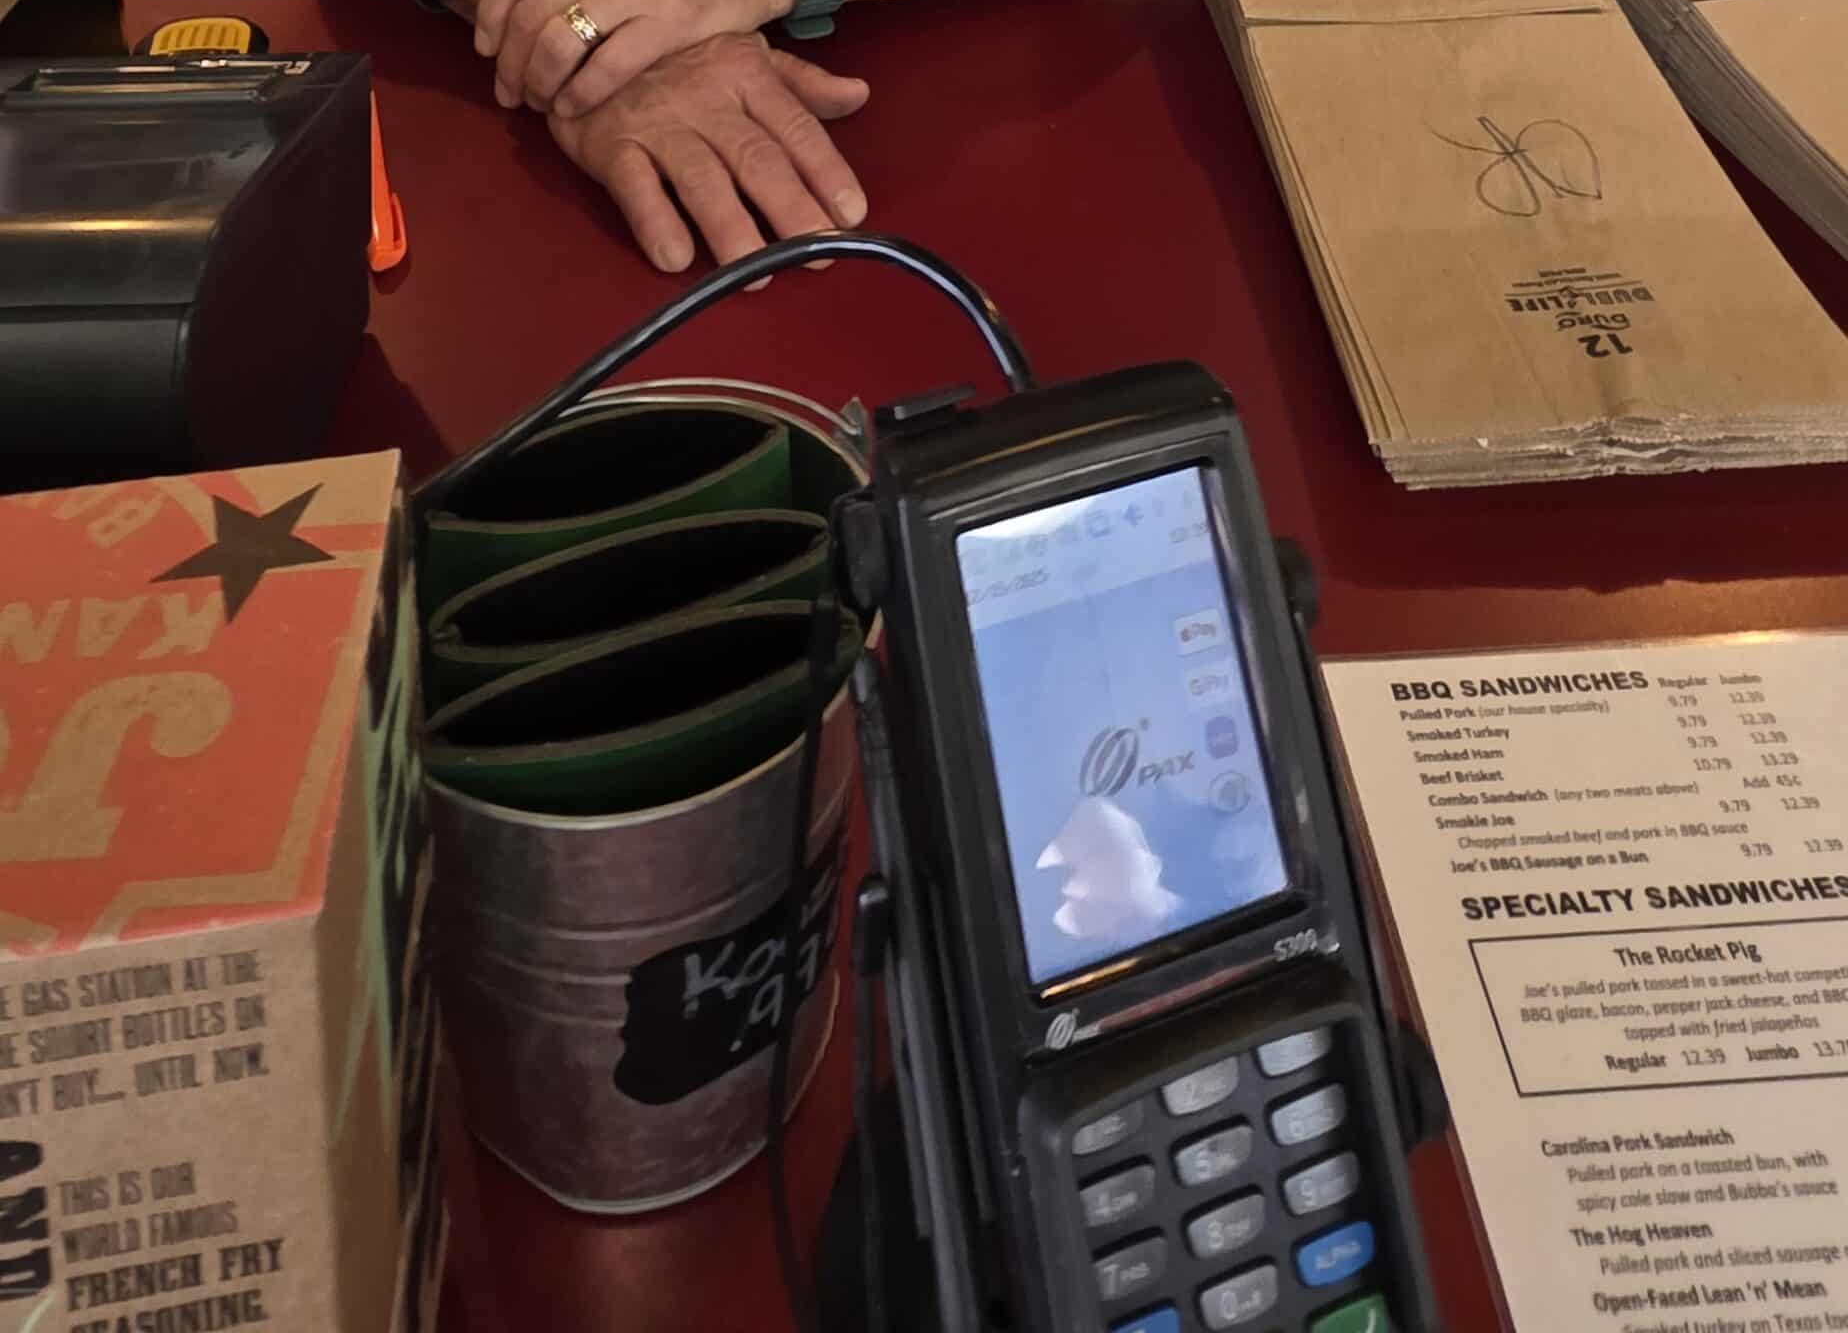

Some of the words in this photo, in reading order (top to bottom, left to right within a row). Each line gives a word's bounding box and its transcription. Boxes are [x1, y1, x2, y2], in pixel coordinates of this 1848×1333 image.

[1577, 333, 1633, 358] 12
[1391, 681, 1453, 701] BBQ
[1460, 671, 1648, 698] SANDWICHES
[1400, 708, 1442, 721] Pulled
[1445, 706, 1476, 719] Pork
[1407, 728, 1461, 742] Smoked
[1463, 725, 1510, 740] Turkey
[1138, 751, 1195, 787] PAX
[1414, 749, 1469, 763] Smoked
[1471, 748, 1504, 760] Ham
[1420, 771, 1451, 785] Beef
[1455, 770, 1504, 783] Brisket
[1428, 793, 1478, 807] Combo
[1480, 789, 1548, 804] Sandwich
[1554, 789, 1582, 803] (any
[1585, 787, 1609, 799] two
[1614, 784, 1653, 797] meats
[1656, 781, 1700, 795] above)
[1435, 814, 1488, 829] Smokie
[1492, 813, 1515, 826] Joe
[1458, 834, 1516, 849] Chopped
[1520, 831, 1571, 845] smoked
[1574, 828, 1602, 845] beef
[1605, 827, 1630, 841] and
[1632, 827, 1661, 841] pork
[1664, 824, 1678, 838] in
[1679, 822, 1710, 837] BBQ
[1712, 822, 1748, 835] sauce
[1451, 859, 1488, 874] Joe's
[1490, 857, 1524, 872] BBQ
[1525, 855, 1583, 870] Sausage
[1587, 854, 1605, 865] on
[1608, 853, 1617, 864] a
[1618, 850, 1649, 865] Bun
[1461, 888, 1634, 920] SPECIALTY
[1644, 875, 1848, 909] SANDWICHES
[1614, 947, 1654, 967] The
[1656, 942, 1726, 964] Rocket
[1727, 939, 1762, 963] Pig
[22, 979, 71, 1017] GAS
[77, 962, 172, 1008] STATION
[183, 956, 208, 992] AT
[219, 949, 263, 985] THE
[1525, 983, 1561, 999] Joe's
[1562, 979, 1606, 998] pulled
[1609, 978, 1640, 995] pork
[1643, 975, 1689, 992] tossed
[1691, 974, 1706, 988] in
[1708, 976, 1718, 987] a
[1520, 1007, 1553, 1023] BBQ
[1653, 999, 1701, 1015] pepper
[1704, 996, 1732, 1013] jack
[1793, 989, 1820, 1005] and
[121, 1001, 226, 1049] BOTTLES
[1624, 1023, 1676, 1042] topped
[1679, 1020, 1710, 1036] with
[1714, 1018, 1747, 1038] fried
[1605, 1052, 1666, 1073] Regular
[1681, 1047, 1726, 1066] 12.39
[1745, 1043, 1799, 1062] Jumbo
[1813, 1039, 1848, 1057] 13.7
[134, 1053, 203, 1097] UNTIL
[1541, 1137, 1611, 1157] Carolina
[1613, 1133, 1654, 1151] Pork
[1654, 1127, 1735, 1149] Sandwich
[1567, 1163, 1616, 1183] Pulled
[1620, 1161, 1654, 1181] pork
[1657, 1163, 1678, 1176] on
[1681, 1162, 1691, 1175] a
[1694, 1154, 1753, 1174] toasted
[1755, 1152, 1791, 1171] bun,
[1793, 1149, 1829, 1167] with
[58, 1175, 110, 1216] THIS
[117, 1170, 143, 1206] IS
[151, 1161, 195, 1200] OUR
[1577, 1195, 1616, 1216] spicy
[1620, 1189, 1652, 1207] cole
[1656, 1187, 1690, 1205] slaw
[1694, 1185, 1725, 1203] and
[1728, 1181, 1791, 1201] Bubba's
[1793, 1181, 1838, 1196] sauce
[60, 1218, 141, 1263] WORLD
[148, 1200, 238, 1247] FAMOUS
[1569, 1227, 1605, 1247] The
[1607, 1225, 1646, 1247] Hog
[1645, 1223, 1714, 1242] Heaven
[64, 1252, 204, 1312] FRENCH
[218, 1237, 285, 1282] FRY
[1600, 1255, 1650, 1275] Pulled
[1654, 1250, 1689, 1275] pork
[1694, 1248, 1724, 1268] and
[1728, 1245, 1773, 1265] sliced
[1776, 1246, 1841, 1264] sausage
[1592, 1285, 1700, 1316] Open-Faced
[1701, 1284, 1746, 1303] Lean
[1773, 1279, 1828, 1299] Mean
